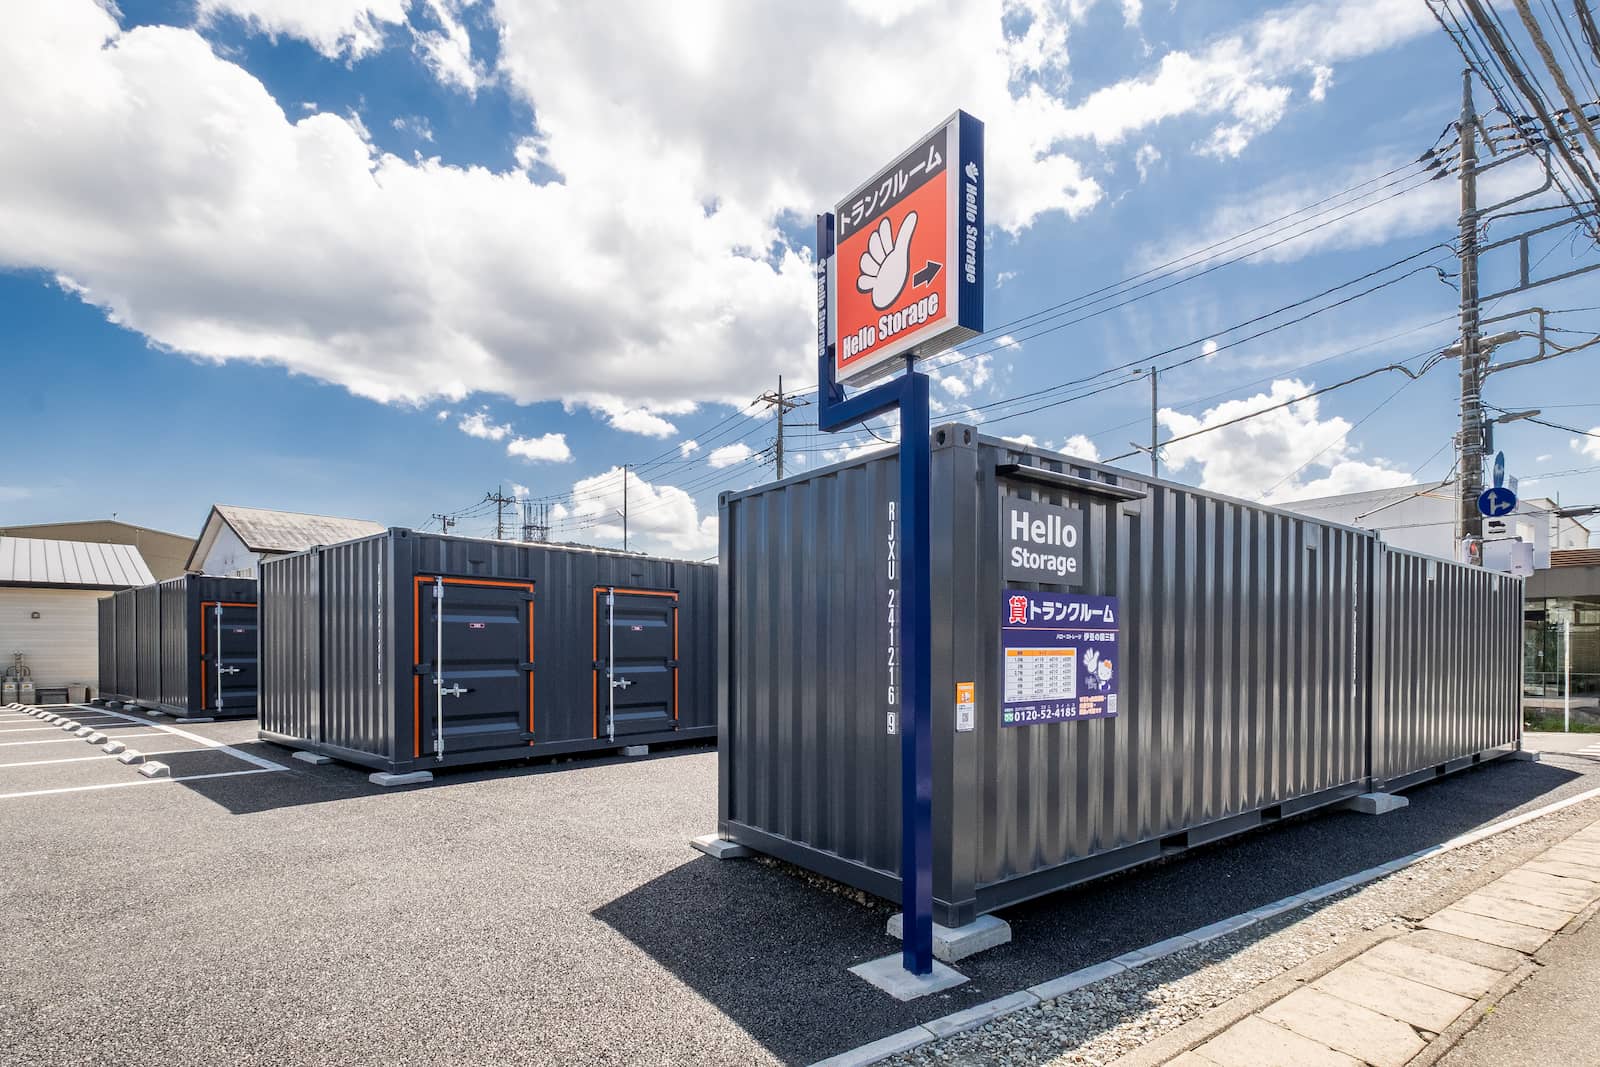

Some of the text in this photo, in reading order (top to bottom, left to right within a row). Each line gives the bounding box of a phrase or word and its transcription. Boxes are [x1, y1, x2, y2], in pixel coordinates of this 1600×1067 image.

[841, 145, 942, 235] トランクルーム
[965, 183, 978, 284] Hello Storage
[842, 292, 940, 360] Hello Storage
[1011, 509, 1077, 548] Hello
[1011, 546, 1077, 577] Storage
[1014, 707, 1077, 722] 0120-52-4185
